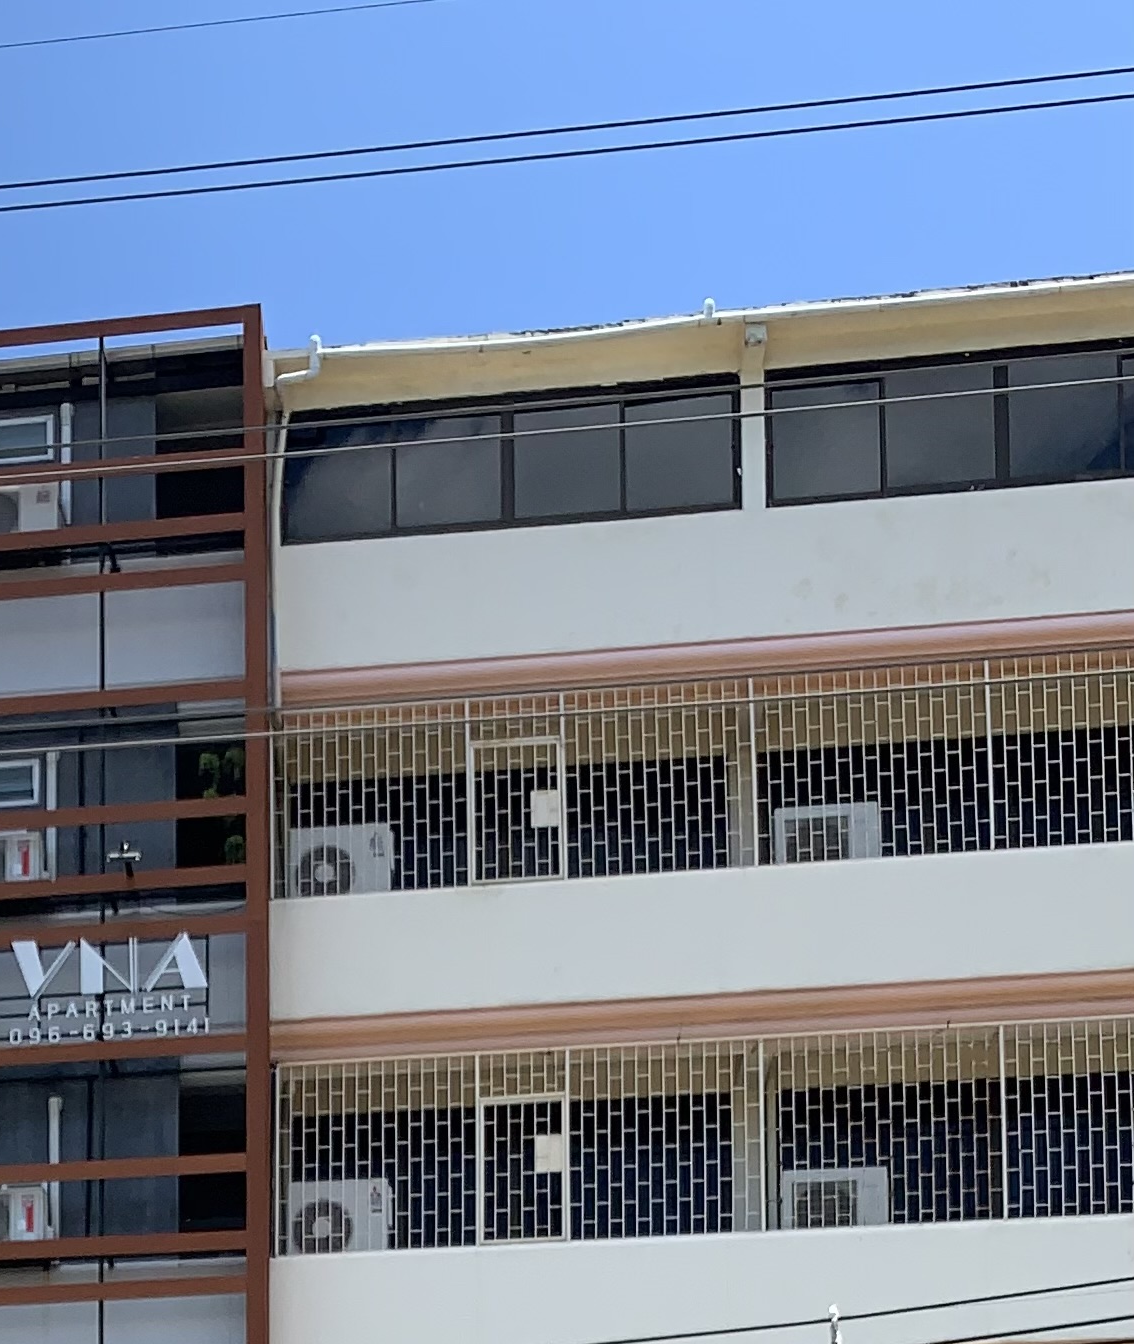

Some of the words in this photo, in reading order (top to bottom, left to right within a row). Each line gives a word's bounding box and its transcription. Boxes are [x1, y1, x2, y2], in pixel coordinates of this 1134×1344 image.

[11, 931, 208, 999] VNA
[27, 994, 193, 1022] APARTMENT
[9, 1017, 211, 1045] 096-693-9141
